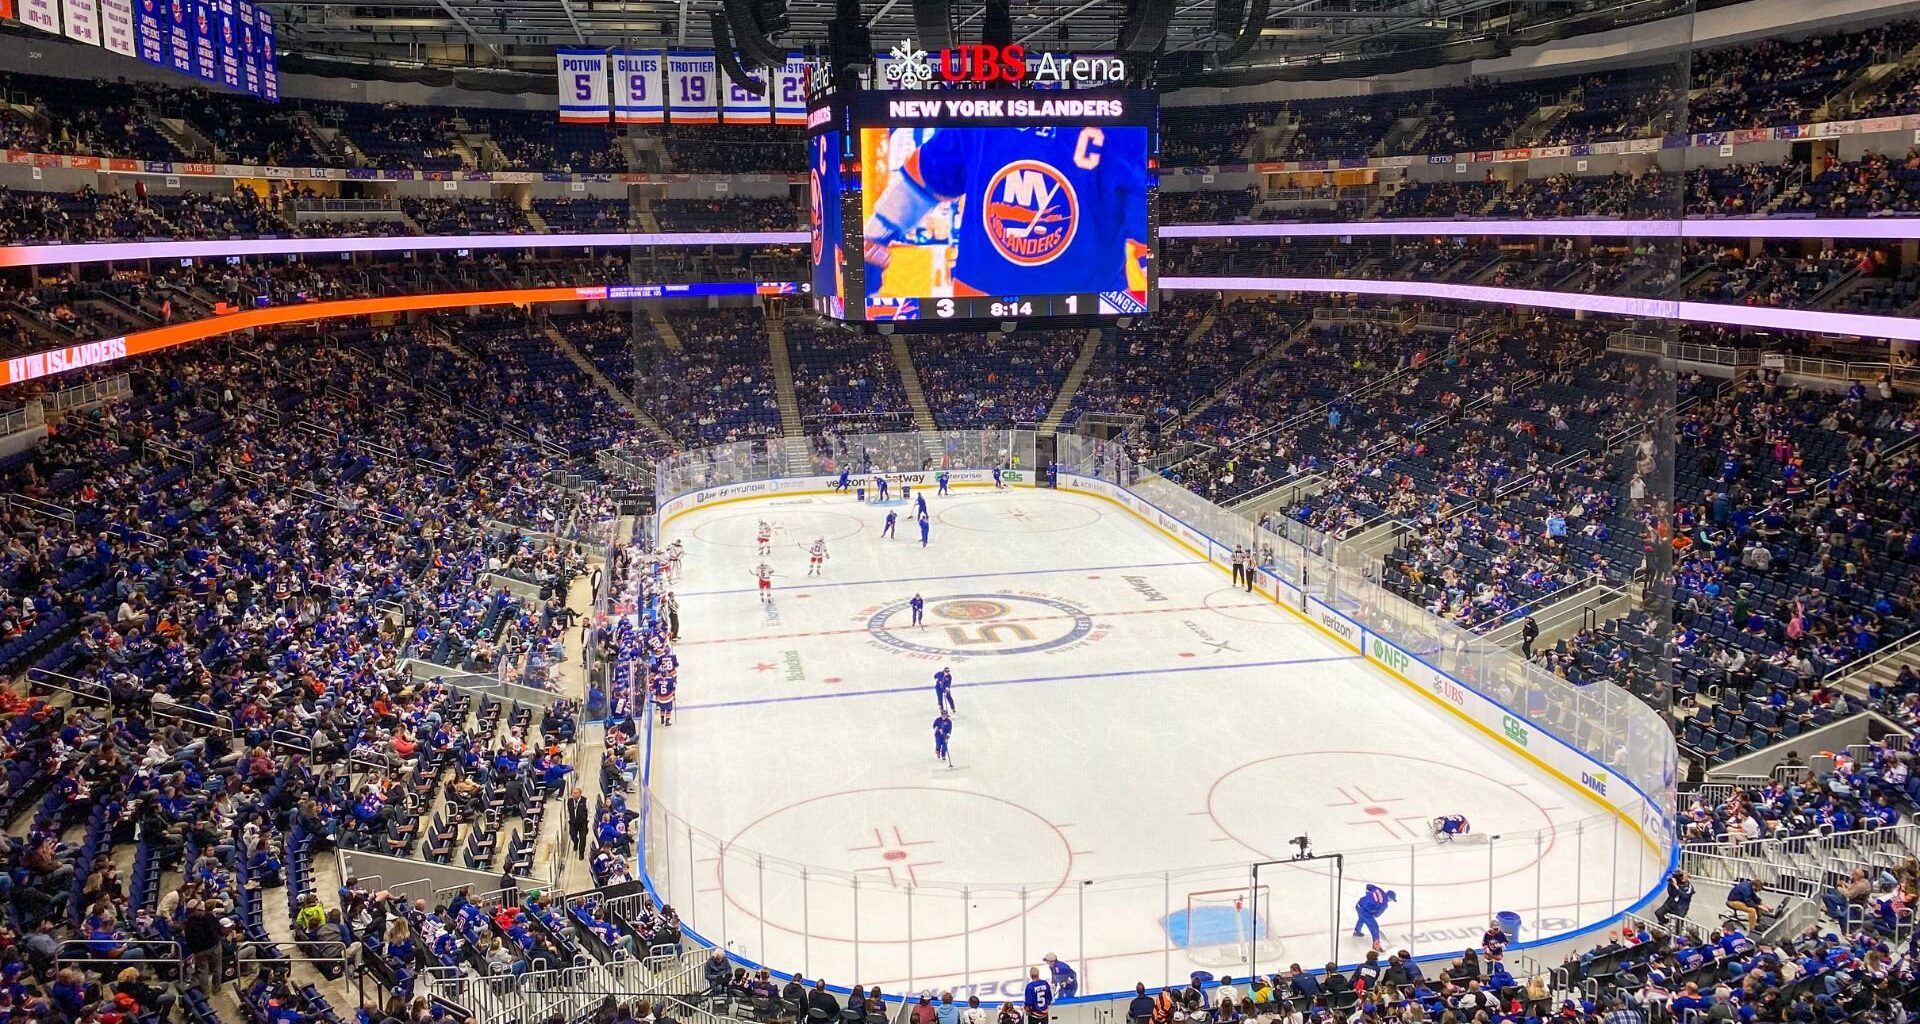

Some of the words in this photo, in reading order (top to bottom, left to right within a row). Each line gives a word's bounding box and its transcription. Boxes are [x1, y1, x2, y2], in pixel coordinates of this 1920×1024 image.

[563, 59, 601, 72] POTVIN
[618, 60, 657, 72] GILLIES
[670, 61, 714, 73] TROTTIER
[940, 44, 1026, 83] UBS
[1034, 52, 1125, 81] Arena
[575, 74, 592, 101] 5
[631, 75, 646, 101] 9
[681, 75, 706, 102] 19
[889, 101, 941, 117] NEW
[946, 100, 1004, 116] YORK
[1007, 100, 1123, 116] ISLANDERS
[936, 299, 955, 318] 3
[990, 302, 1033, 316] 8:14
[1065, 295, 1078, 314] 1
[47, 337, 127, 376] ISLANDERS
[730, 484, 765, 494] HYUNDAI
[1321, 612, 1352, 640] verizon
[1383, 640, 1409, 673] NFP
[1444, 684, 1464, 706] UBS
[1581, 771, 1607, 797] DIME
[1037, 991, 1046, 1008] 5
